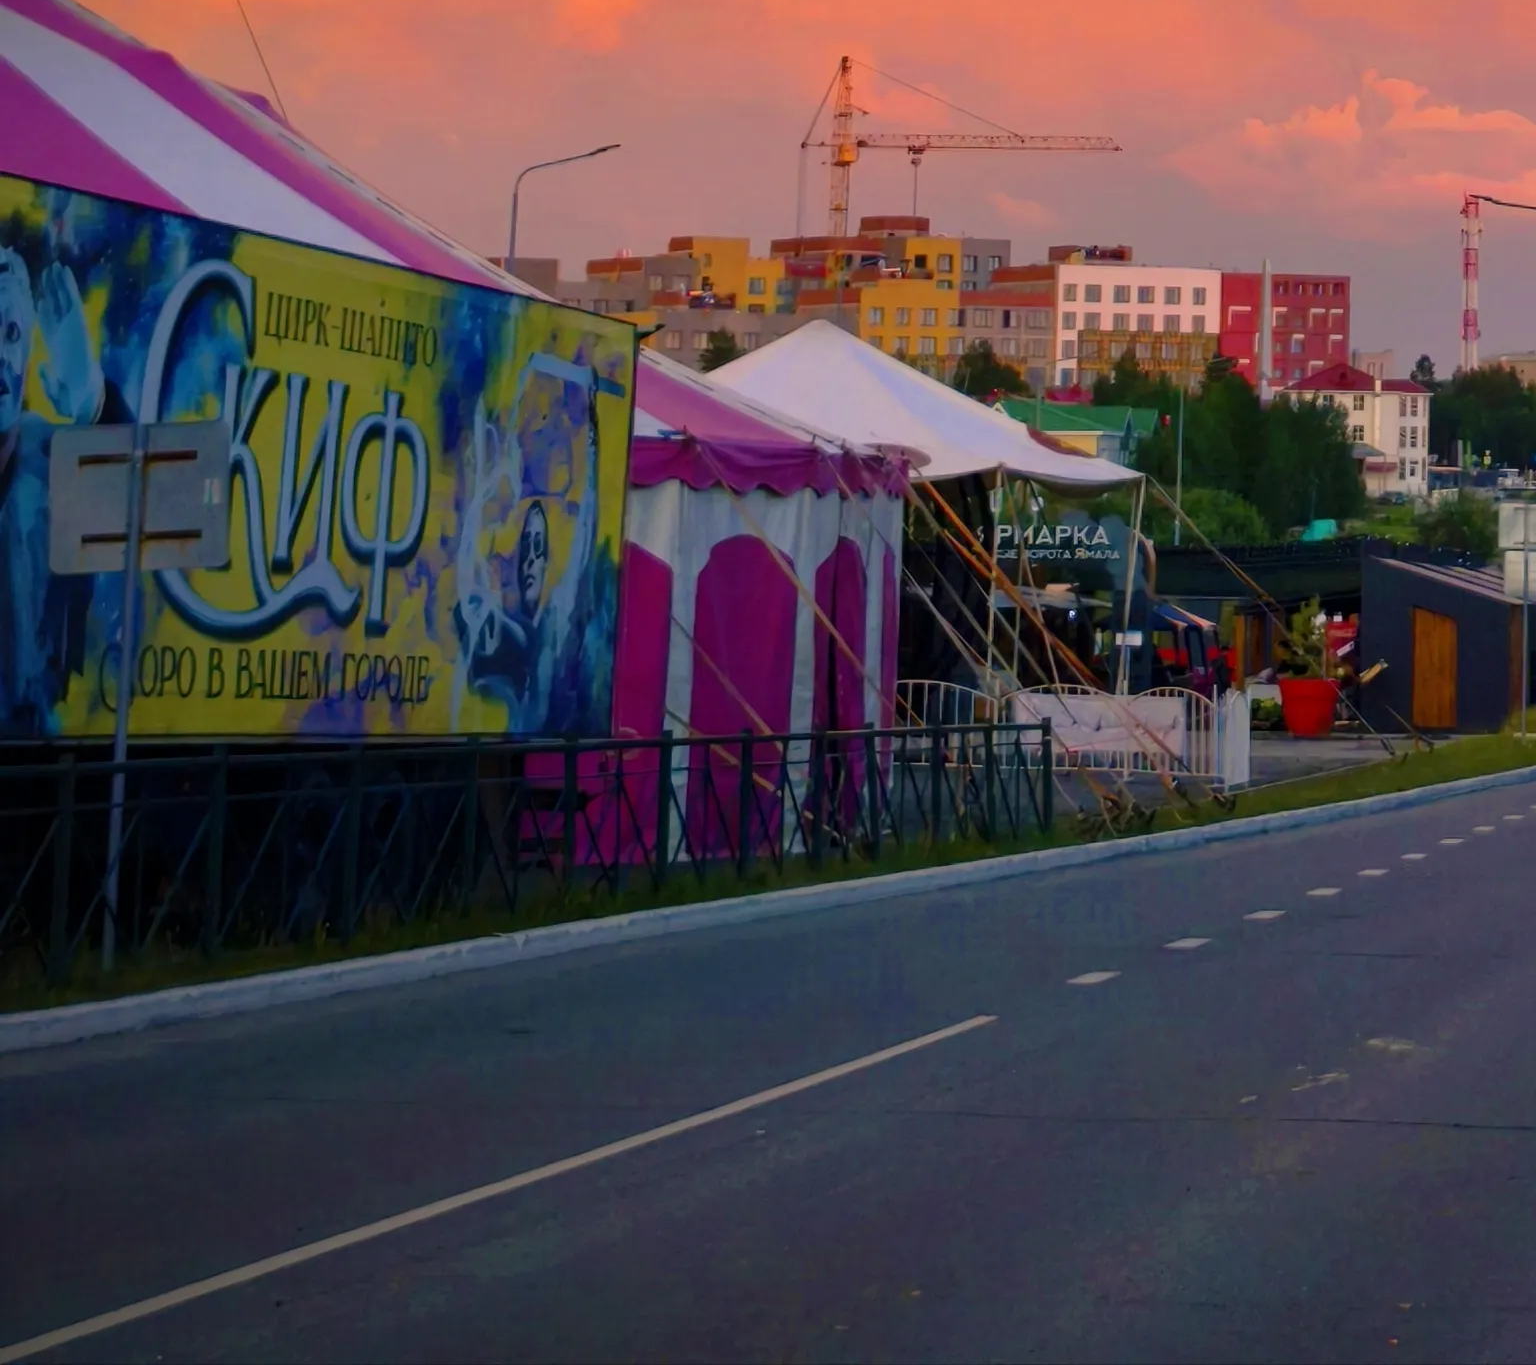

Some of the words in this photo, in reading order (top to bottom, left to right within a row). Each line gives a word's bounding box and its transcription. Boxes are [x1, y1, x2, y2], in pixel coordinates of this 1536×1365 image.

[263, 290, 438, 368] ЦИРК-ШАПИТО
[990, 524, 1112, 546] РМАРКА
[99, 642, 197, 713] СОРО
[205, 647, 226, 699] В
[234, 648, 333, 701] ВАШЕМ
[339, 652, 430, 707] ГОРОДЕ
